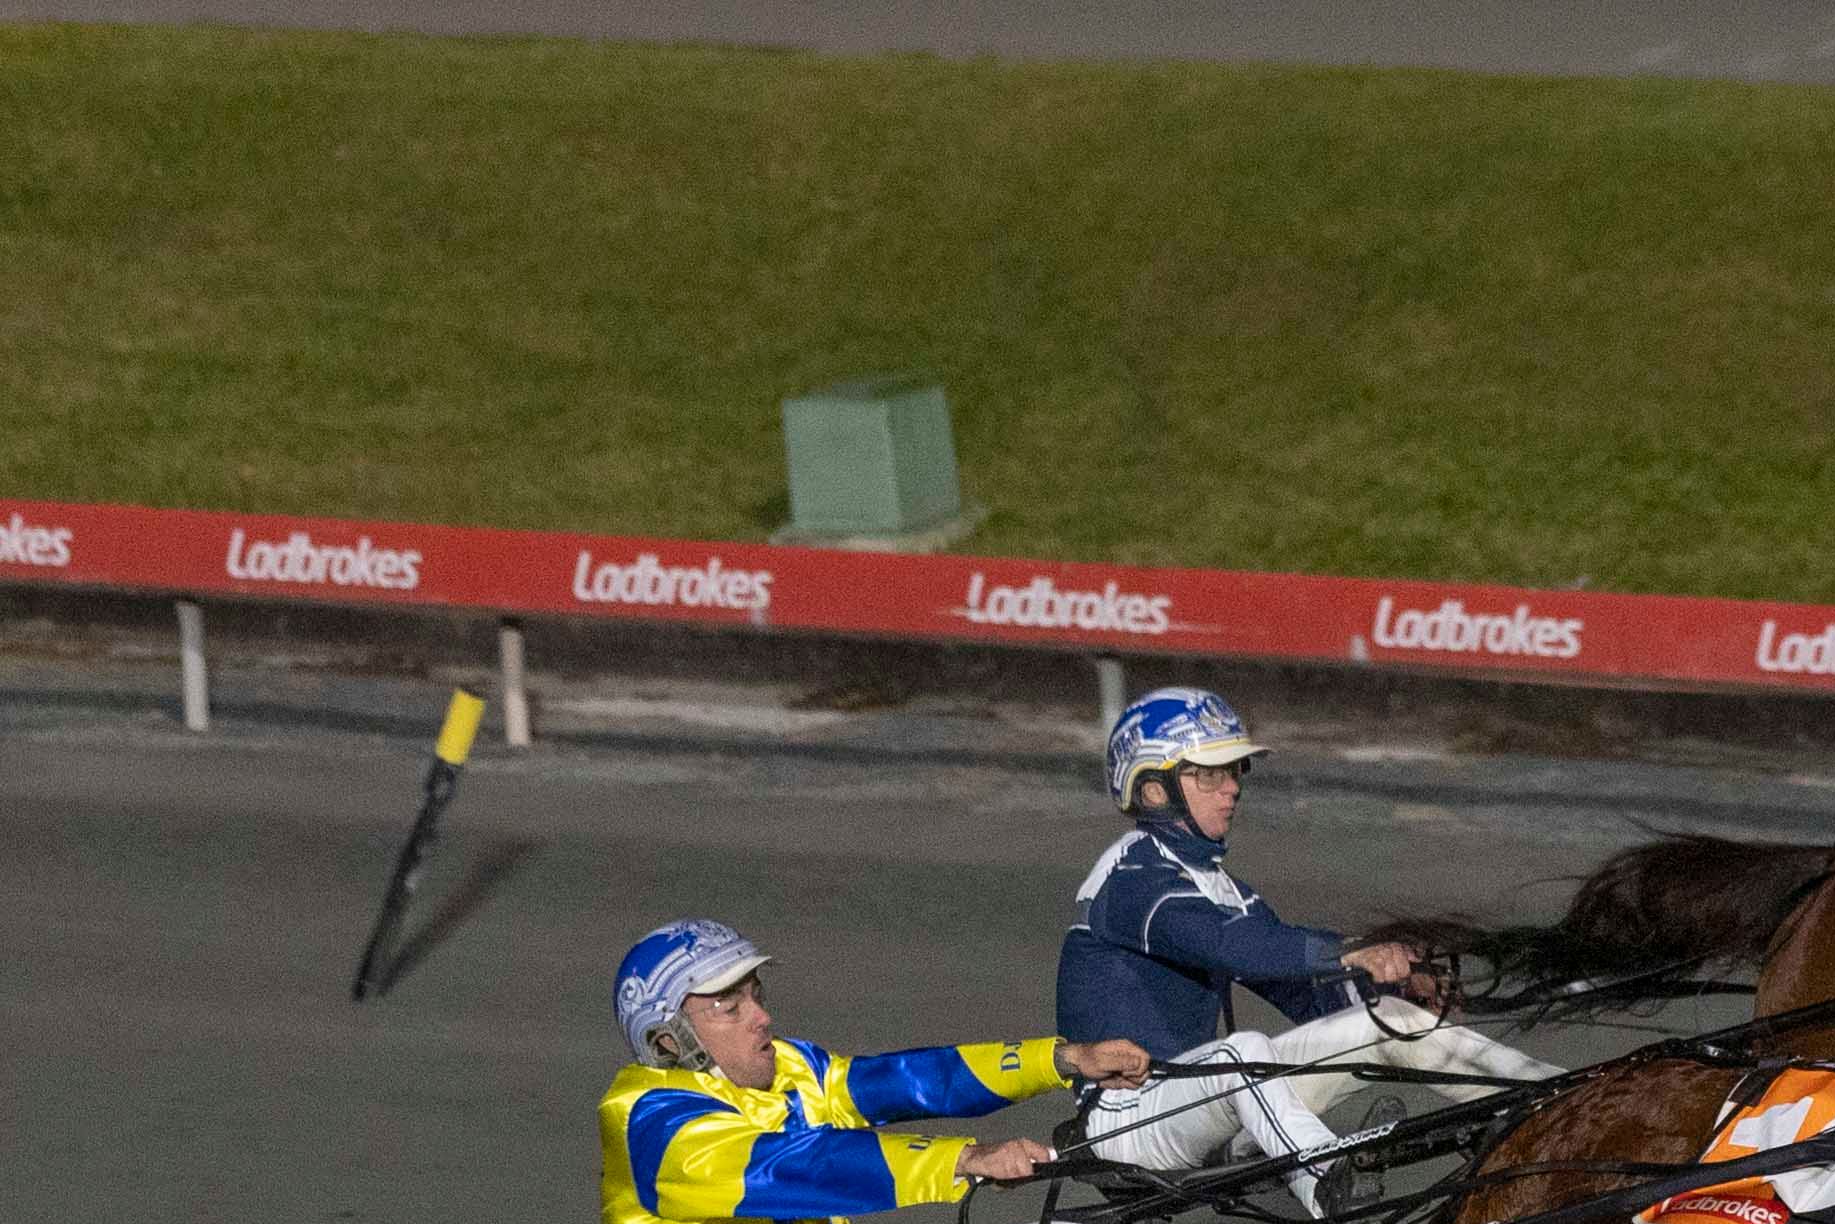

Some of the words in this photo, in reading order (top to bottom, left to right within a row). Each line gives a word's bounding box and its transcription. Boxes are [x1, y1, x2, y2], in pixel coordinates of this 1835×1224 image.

[227, 529, 423, 590] Ladbrokes
[574, 550, 773, 612] Ladbrokes
[966, 572, 1173, 635] Ladbrokes
[1373, 597, 1583, 661] Ladbrokes
